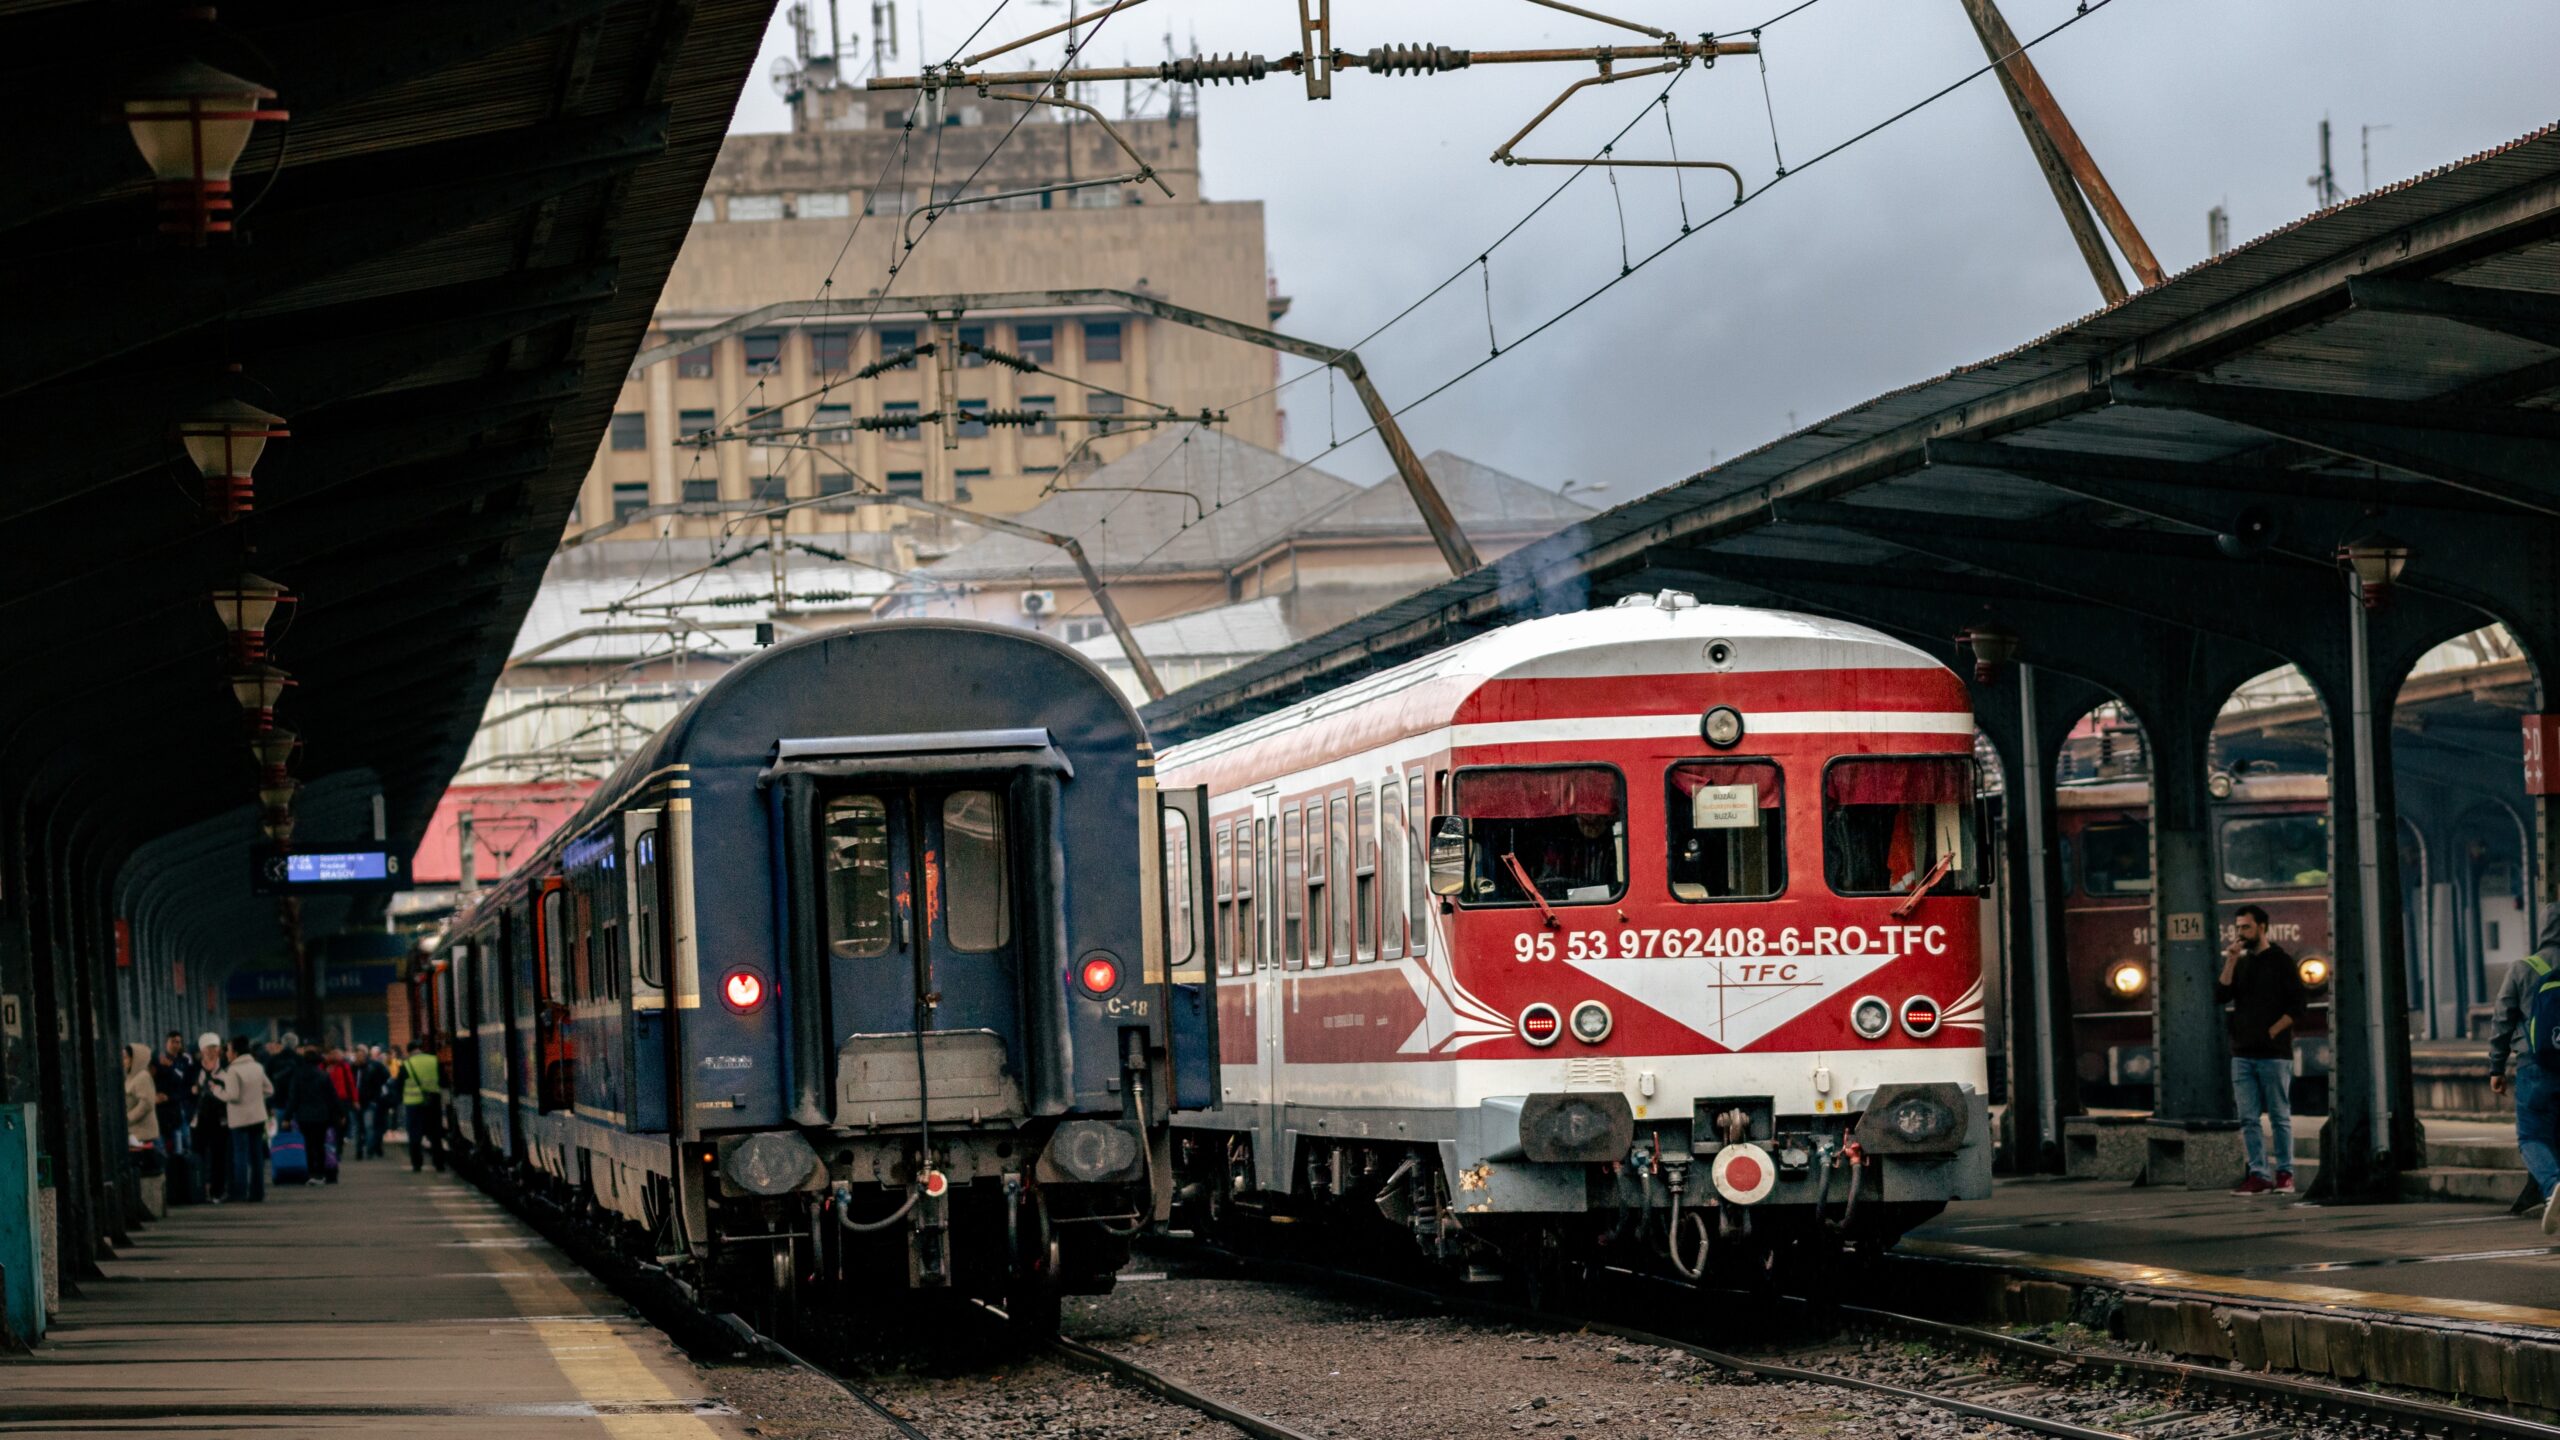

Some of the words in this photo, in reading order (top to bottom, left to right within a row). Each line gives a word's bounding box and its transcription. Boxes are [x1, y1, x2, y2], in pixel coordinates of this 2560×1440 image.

[388, 855, 399, 874] 6
[2173, 918, 2200, 935] 134
[1514, 932, 1556, 963] 95
[1567, 930, 1608, 960] 53
[1619, 925, 1946, 959] 9762408-6-RO-TFC
[2133, 927, 2148, 945] 91
[1739, 964, 1798, 982] TFC
[1108, 997, 1148, 1017] C-18
